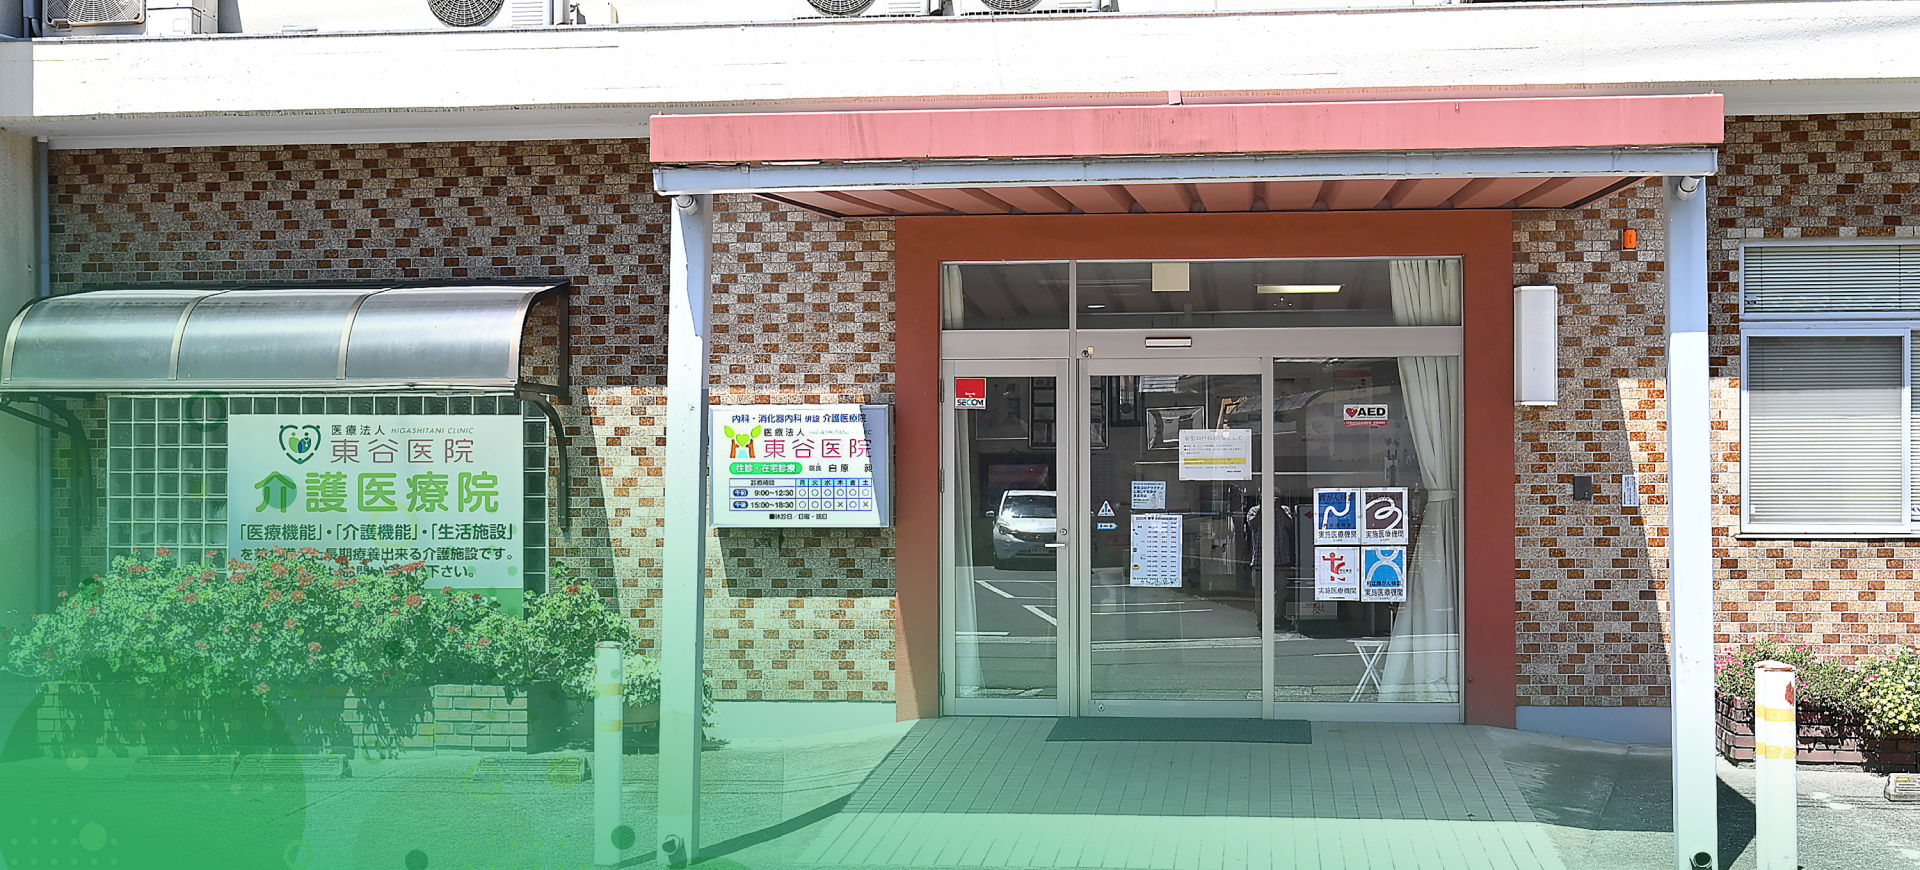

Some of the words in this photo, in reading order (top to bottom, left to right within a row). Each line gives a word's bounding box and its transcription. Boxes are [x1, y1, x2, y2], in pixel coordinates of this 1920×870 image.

[1357, 408, 1386, 416] AED
[822, 414, 868, 423] 介護医療院
[331, 424, 386, 436] 医療法人
[764, 428, 805, 437] 医療法人
[330, 438, 475, 464] 東谷医院
[764, 439, 873, 458] 東谷医院
[254, 470, 500, 513] 介護医療院
